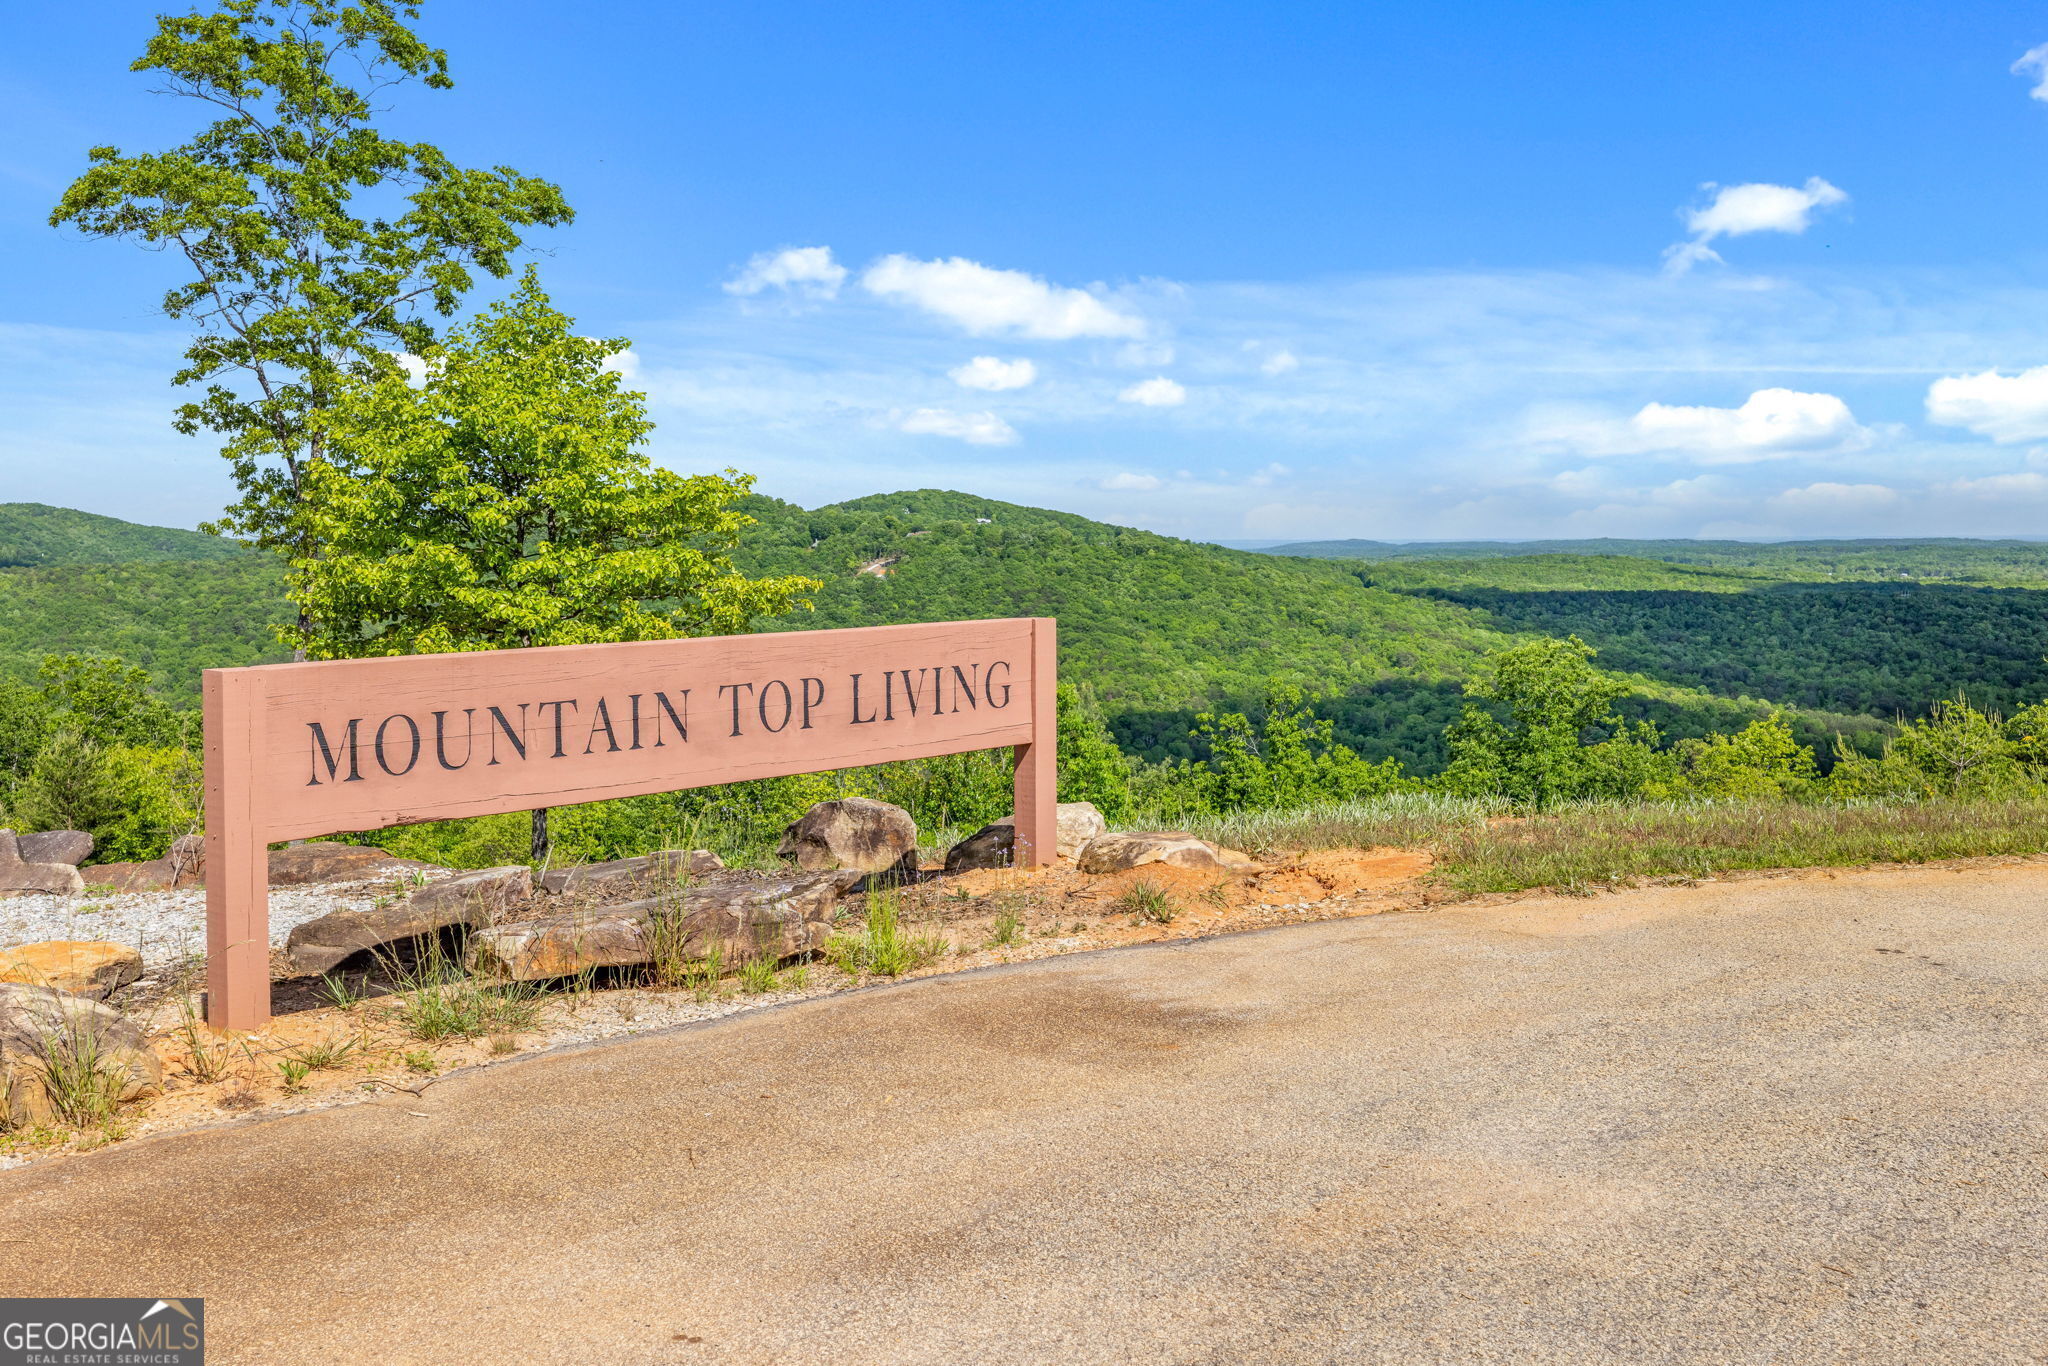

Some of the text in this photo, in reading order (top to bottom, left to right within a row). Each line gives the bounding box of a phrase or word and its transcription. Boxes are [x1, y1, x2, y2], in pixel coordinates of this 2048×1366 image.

[306, 661, 1012, 787] MOUNTAIN TOP LIVING
